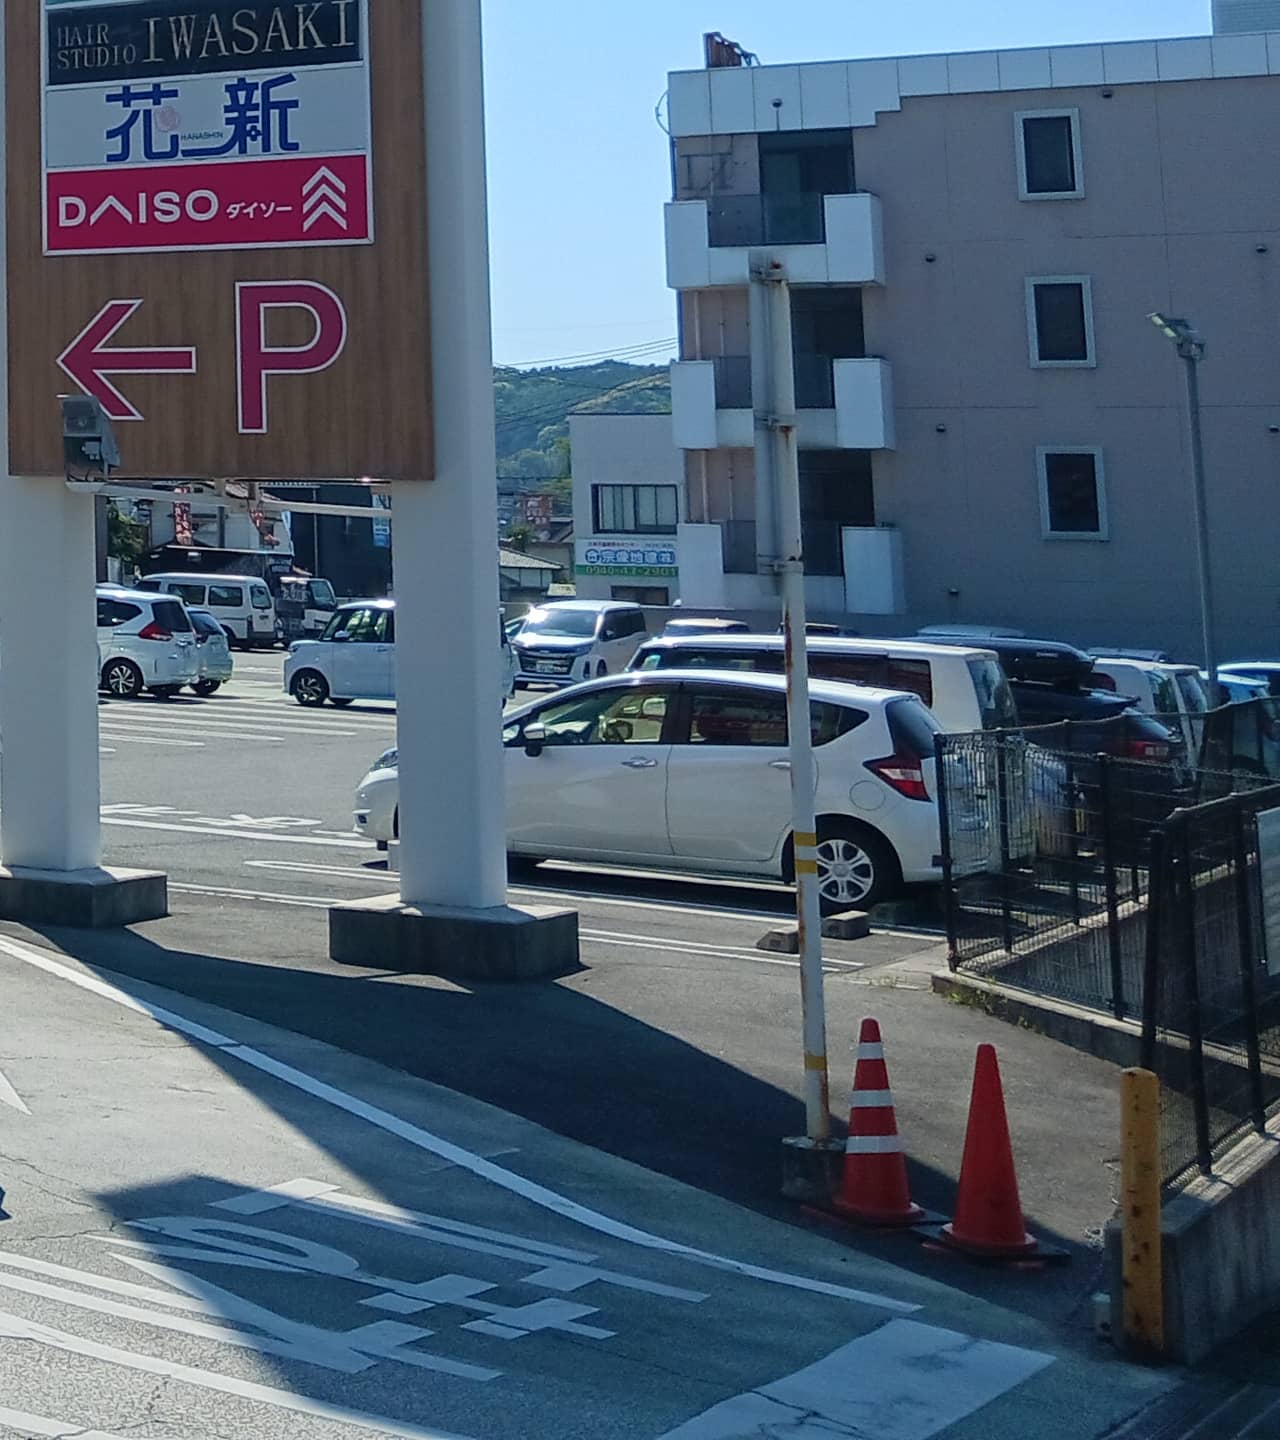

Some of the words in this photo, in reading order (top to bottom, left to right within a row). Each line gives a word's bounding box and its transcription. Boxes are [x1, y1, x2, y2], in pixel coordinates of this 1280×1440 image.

[57, 23, 109, 47] HAIR
[142, 0, 354, 62] IWASAKI
[57, 45, 136, 69] STUDIO
[58, 188, 218, 228] DAISO
[226, 201, 293, 220] ダイソー
[234, 280, 348, 434] P
